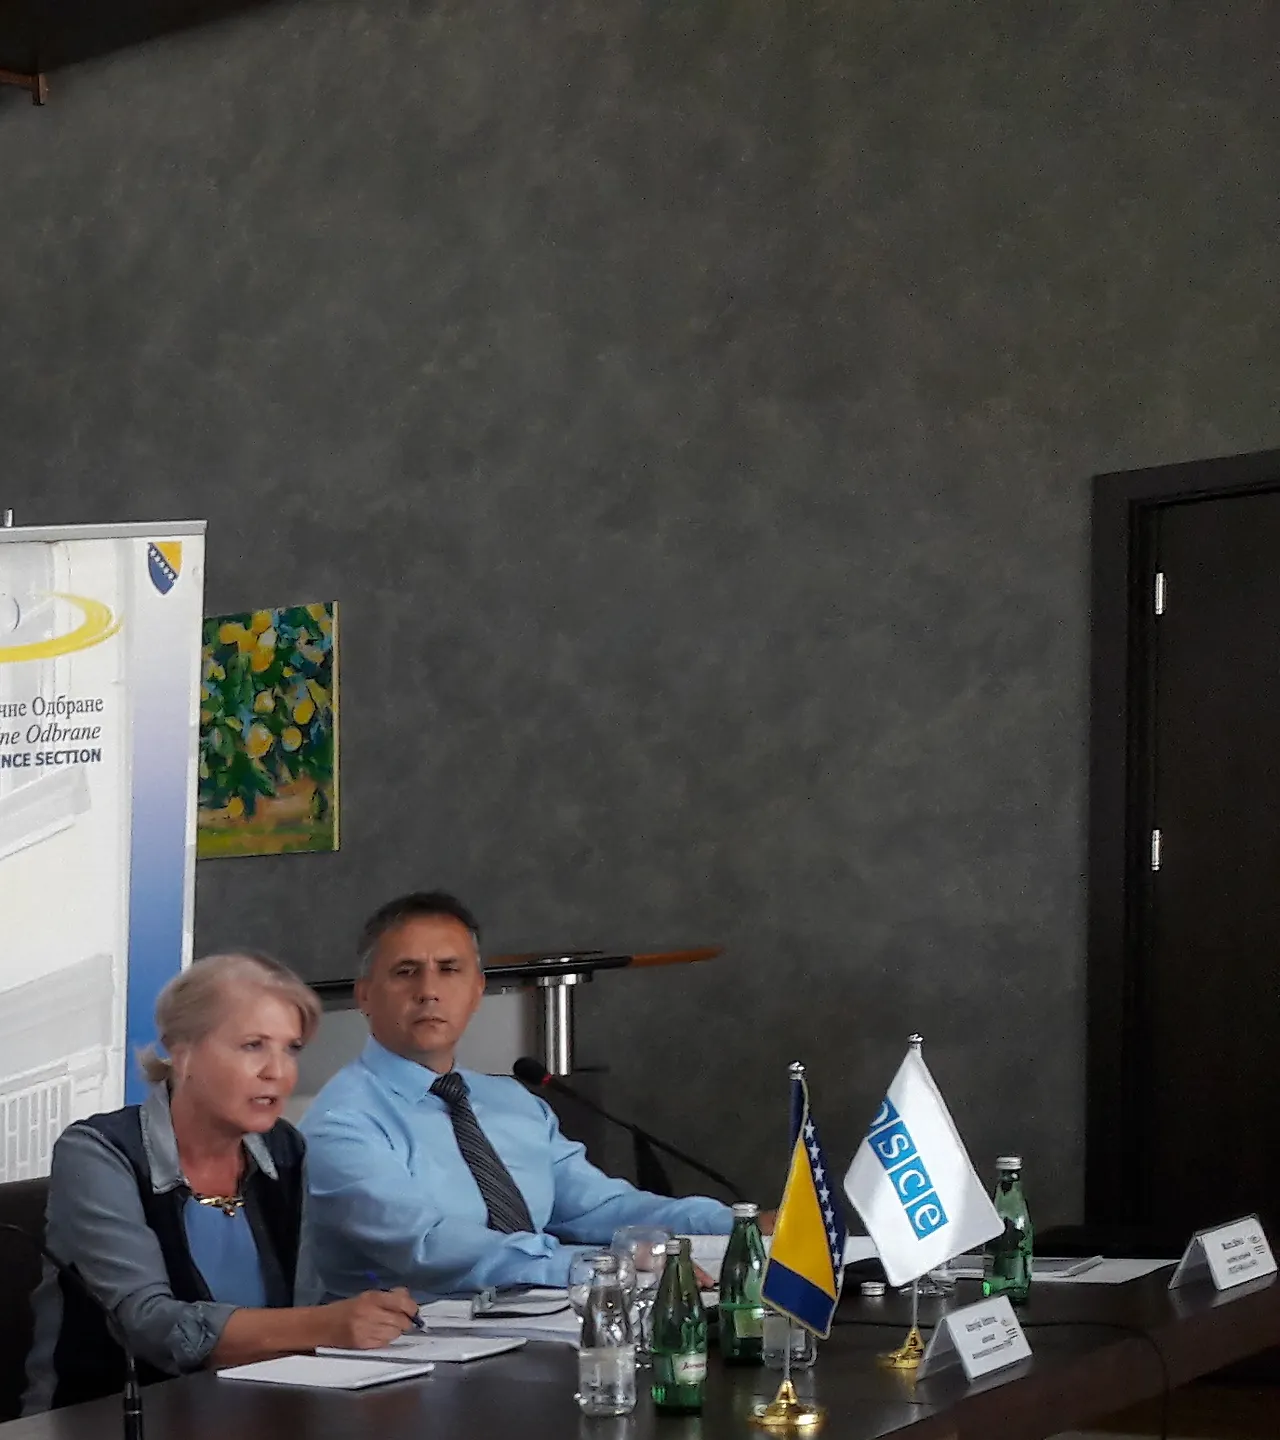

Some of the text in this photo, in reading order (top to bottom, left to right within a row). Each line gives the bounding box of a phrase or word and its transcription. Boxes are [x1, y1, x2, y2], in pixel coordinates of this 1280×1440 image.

[32, 695, 104, 718] Одбране
[26, 723, 102, 744] Odbrane
[35, 748, 102, 766] SECTION
